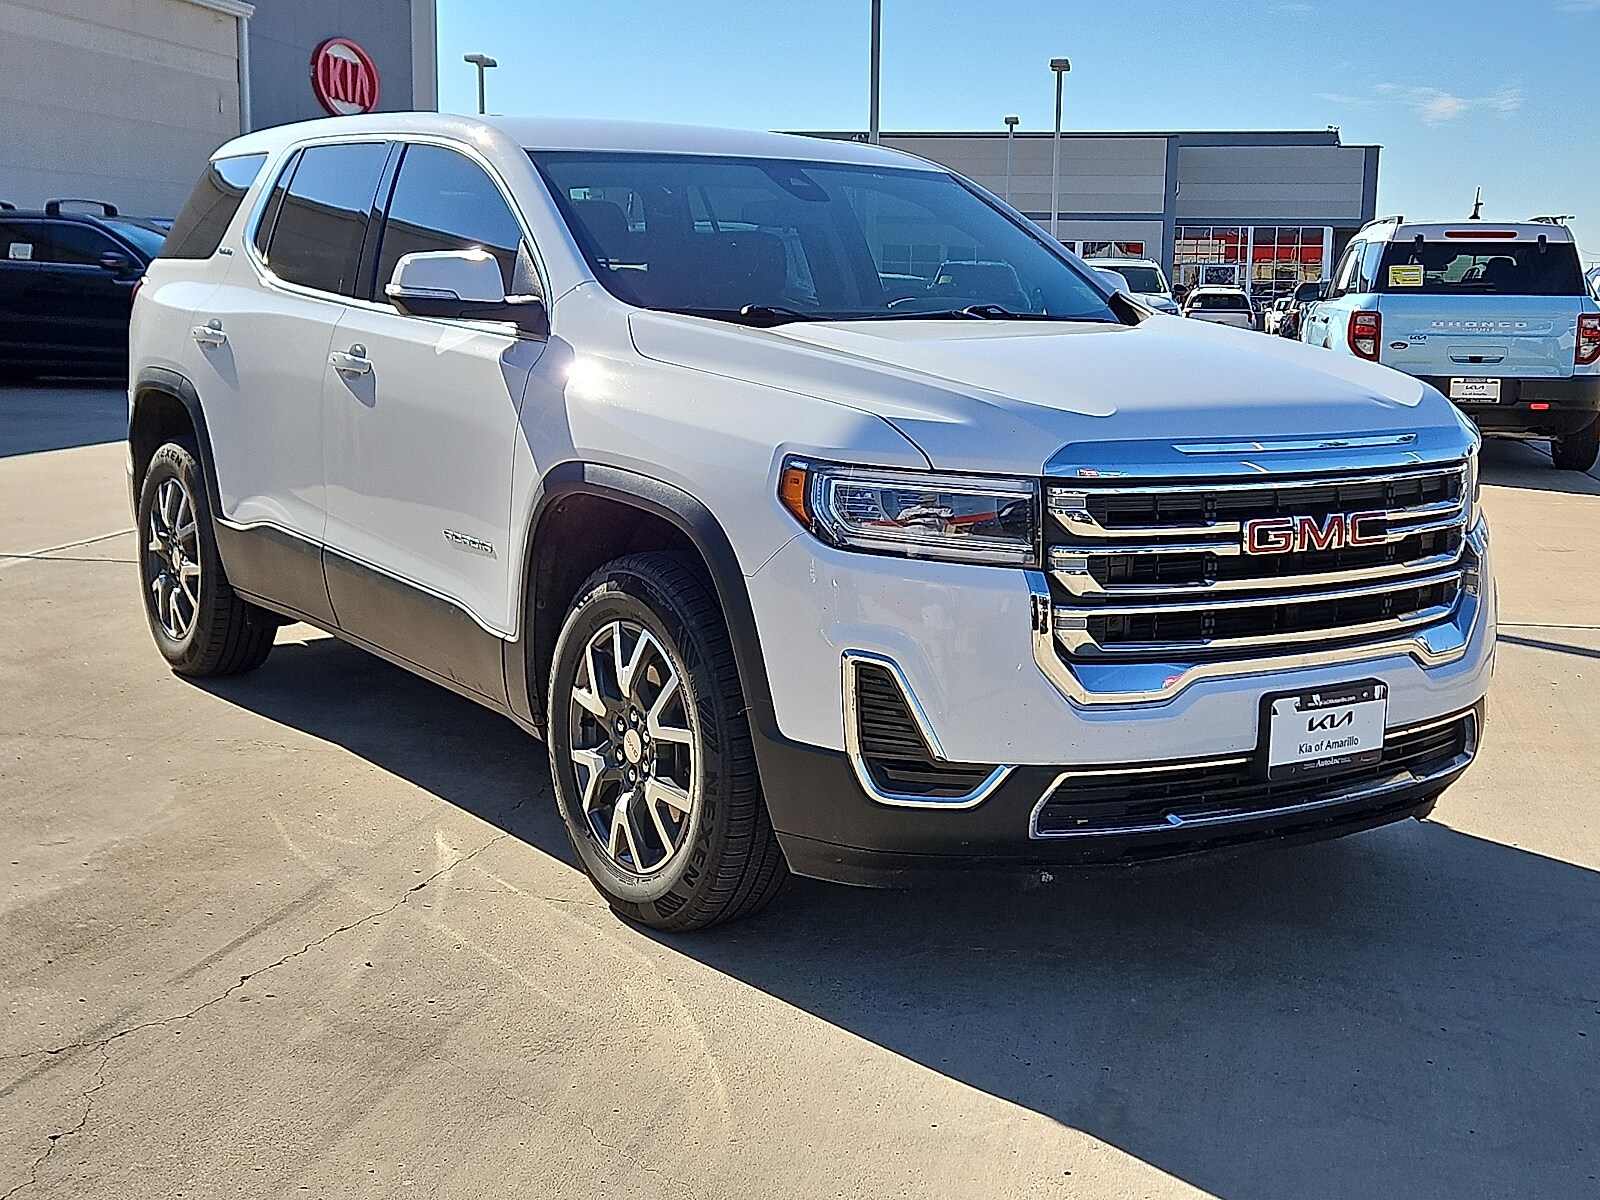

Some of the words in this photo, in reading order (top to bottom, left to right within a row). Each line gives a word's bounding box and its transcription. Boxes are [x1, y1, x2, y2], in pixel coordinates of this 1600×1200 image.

[329, 53, 371, 108] KIA
[1243, 510, 1388, 555] GMC
[1308, 710, 1354, 732] KIA
[1298, 743, 1313, 755] Kia
[1314, 741, 1324, 751] of
[1325, 736, 1360, 751] Amarillo
[682, 770, 719, 888] NEXEN
